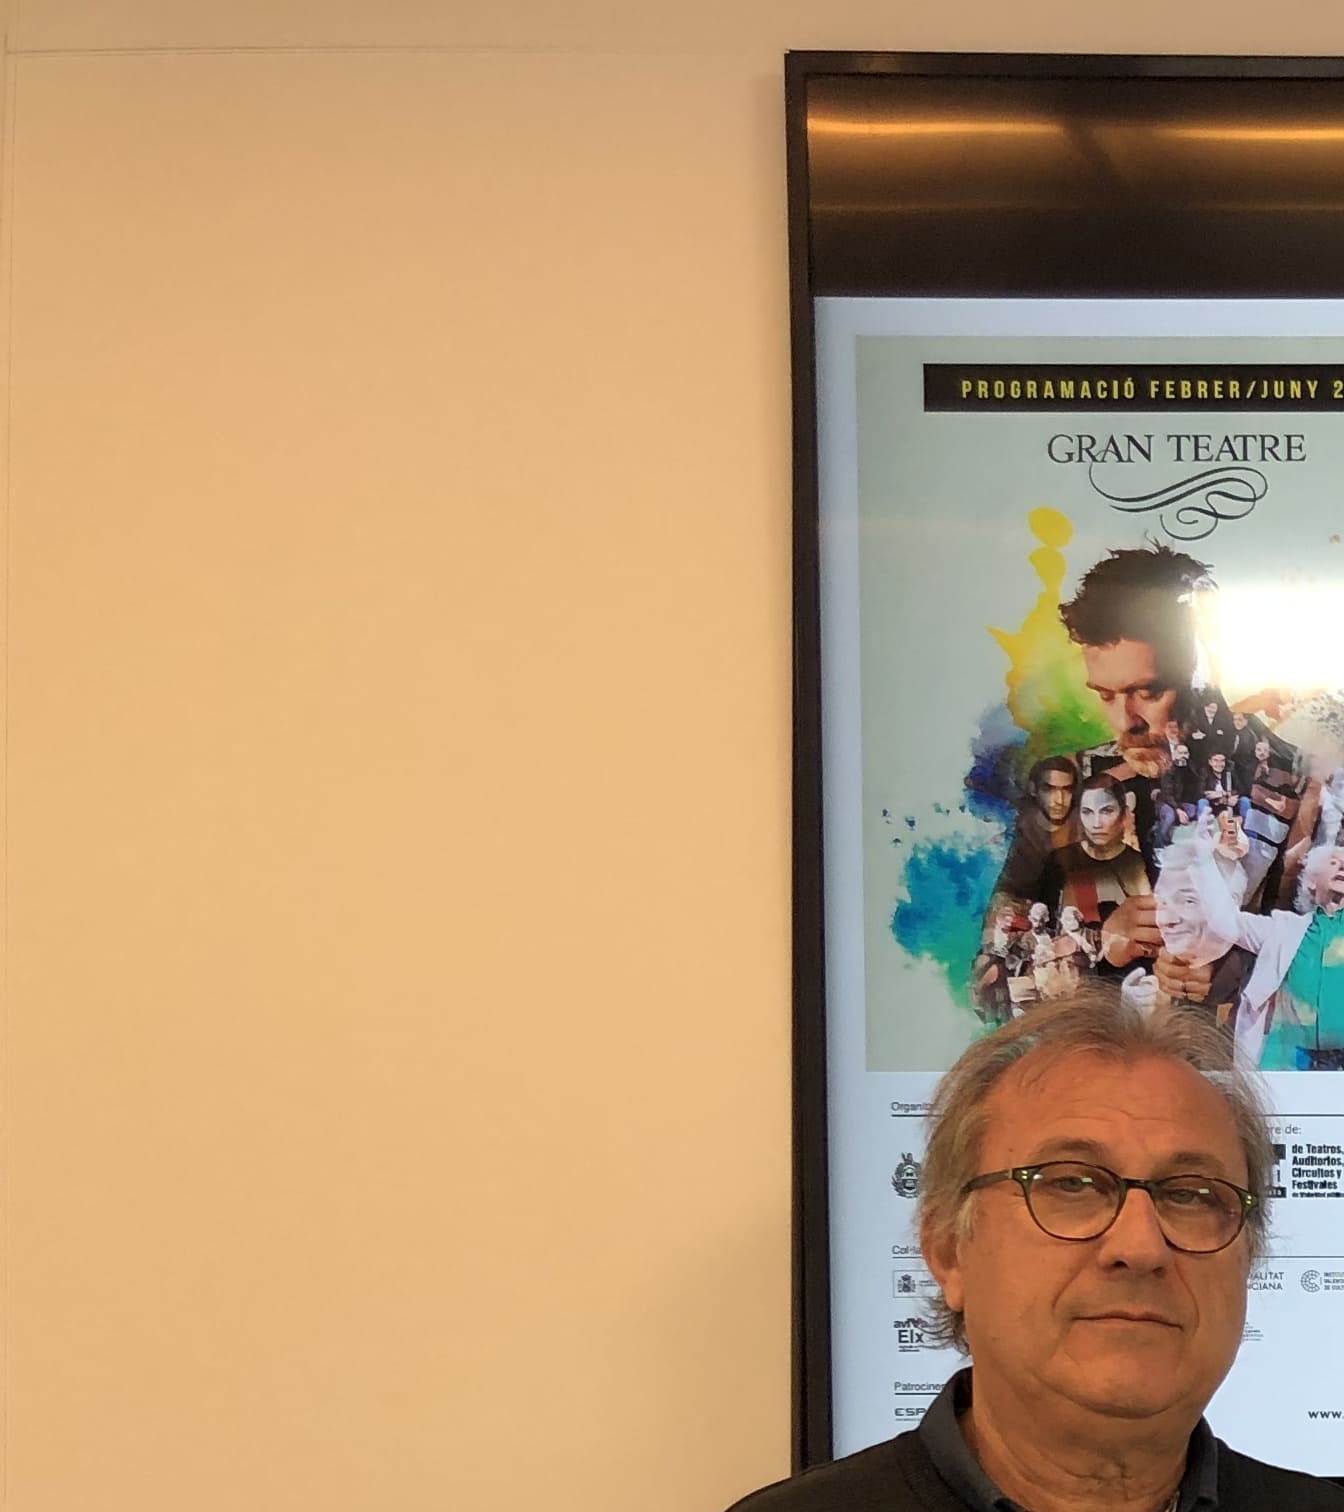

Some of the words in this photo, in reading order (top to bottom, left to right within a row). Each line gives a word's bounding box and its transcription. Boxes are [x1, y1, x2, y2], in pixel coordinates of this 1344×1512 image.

[962, 378, 1134, 399] PROGRAMACIÓ
[1151, 380, 1317, 398] FEBRER/JUNY
[1048, 434, 1154, 466] GRAN
[1167, 435, 1306, 461] TEATRE
[1292, 1144, 1303, 1153] de
[1306, 1144, 1344, 1154] Teatros,
[1292, 1156, 1344, 1166] Auditorios,
[1292, 1168, 1334, 1178] Circuitos
[1337, 1170, 1341, 1179] y
[1292, 1180, 1337, 1190] Festivales
